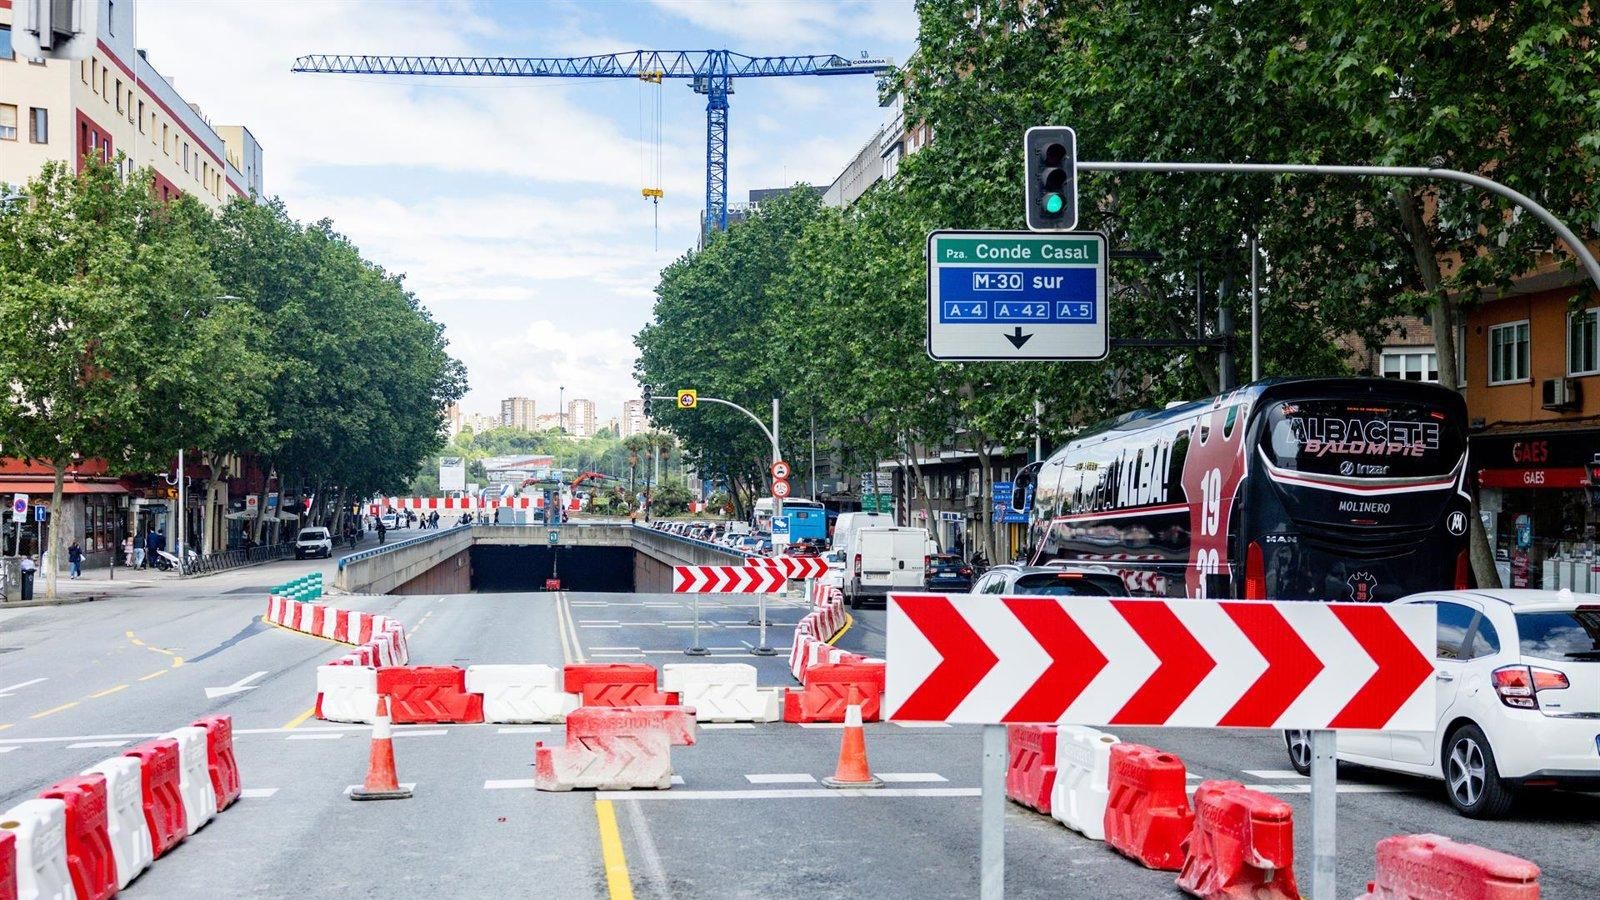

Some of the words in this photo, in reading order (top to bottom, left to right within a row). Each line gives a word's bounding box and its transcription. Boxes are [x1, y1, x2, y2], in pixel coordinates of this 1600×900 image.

[946, 249, 968, 259] Pza.
[975, 243, 1032, 260] Conde
[1041, 243, 1089, 260] Casal
[975, 273, 1021, 289] M-30
[1032, 274, 1064, 289] sur
[1286, 417, 1439, 449] ALBACETE
[1512, 441, 1549, 463] GAES
[1116, 440, 1173, 508] ALBA!
[1523, 471, 1545, 484] GAES
[1200, 467, 1222, 536] 19
[1338, 501, 1391, 514] MOLINERO
[1266, 535, 1298, 543] MAN
